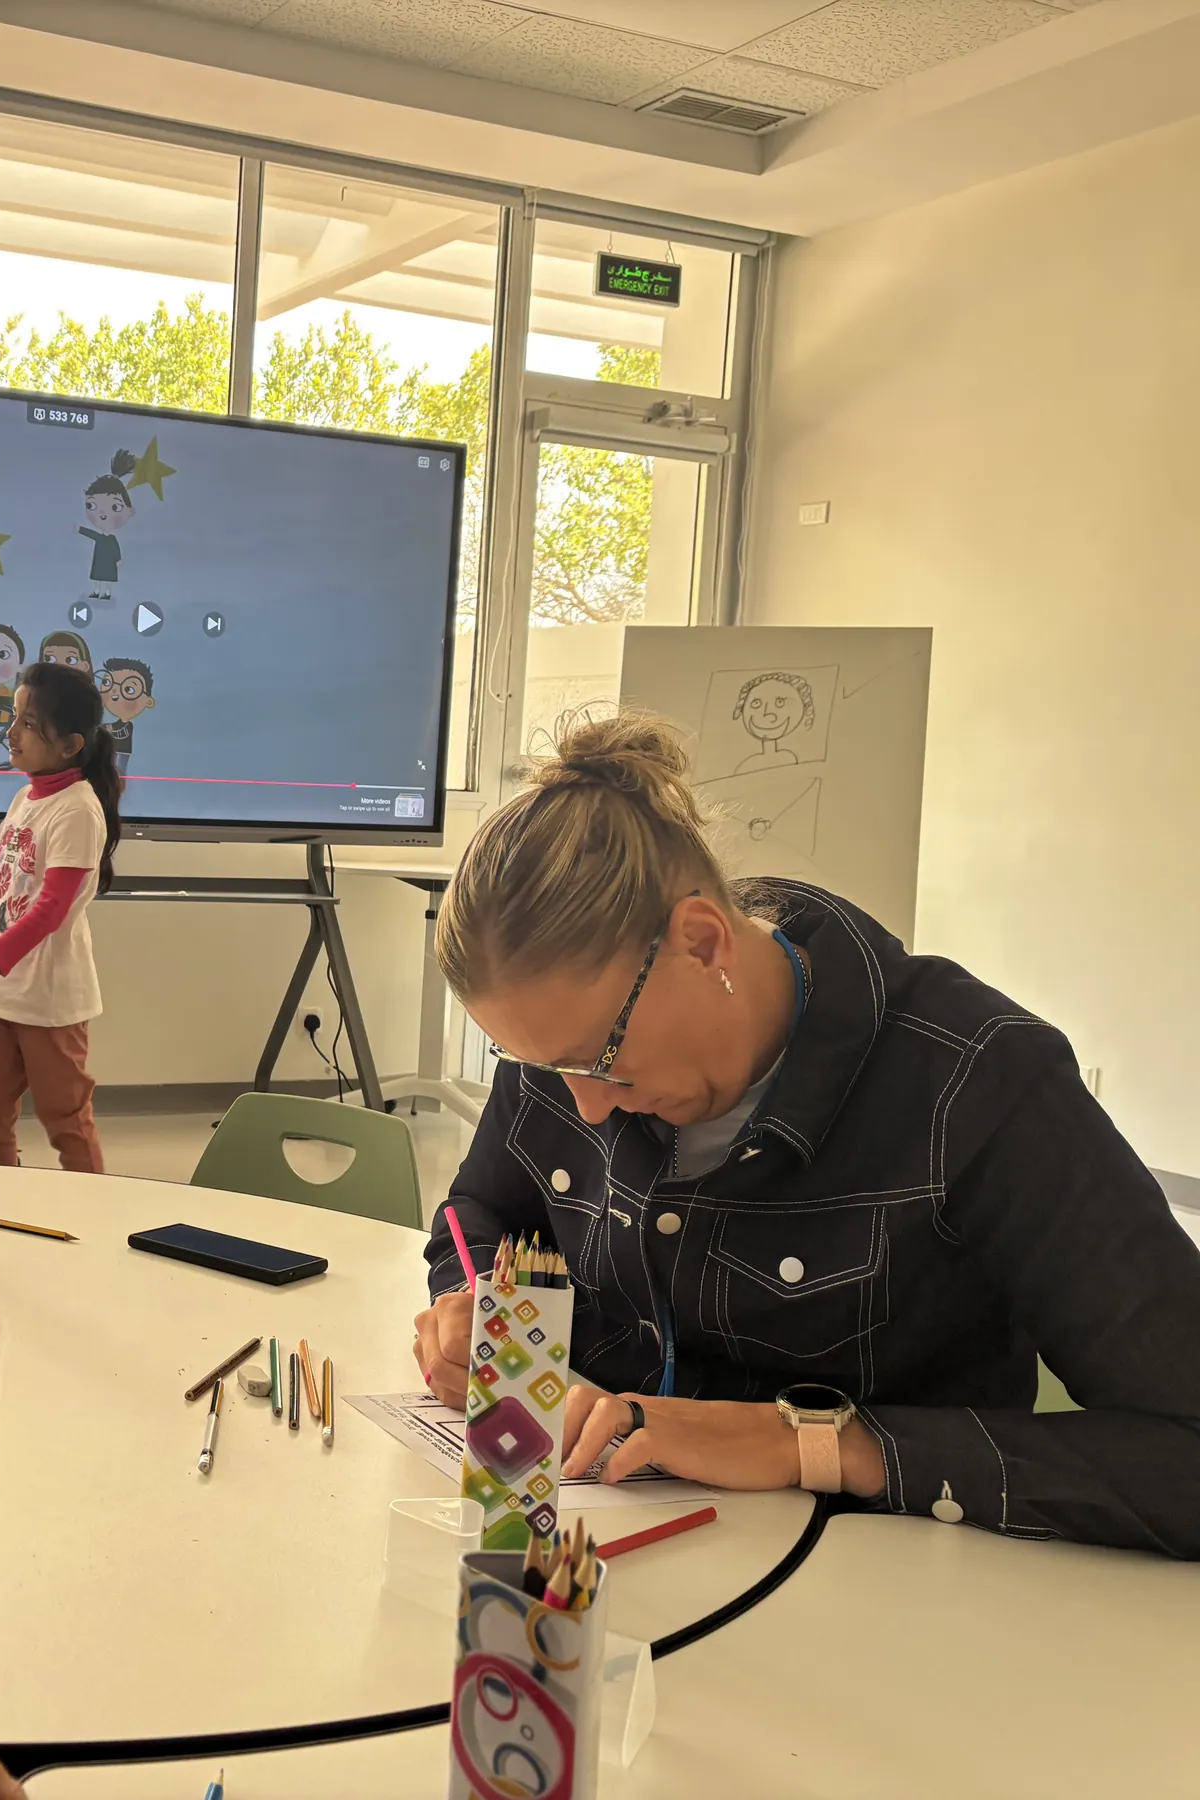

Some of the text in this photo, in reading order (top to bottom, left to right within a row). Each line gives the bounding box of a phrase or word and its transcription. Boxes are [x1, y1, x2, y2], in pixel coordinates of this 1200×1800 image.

[609, 277, 670, 296] EMERGENCY EXIT
[49, 410, 88, 424] 533 768
